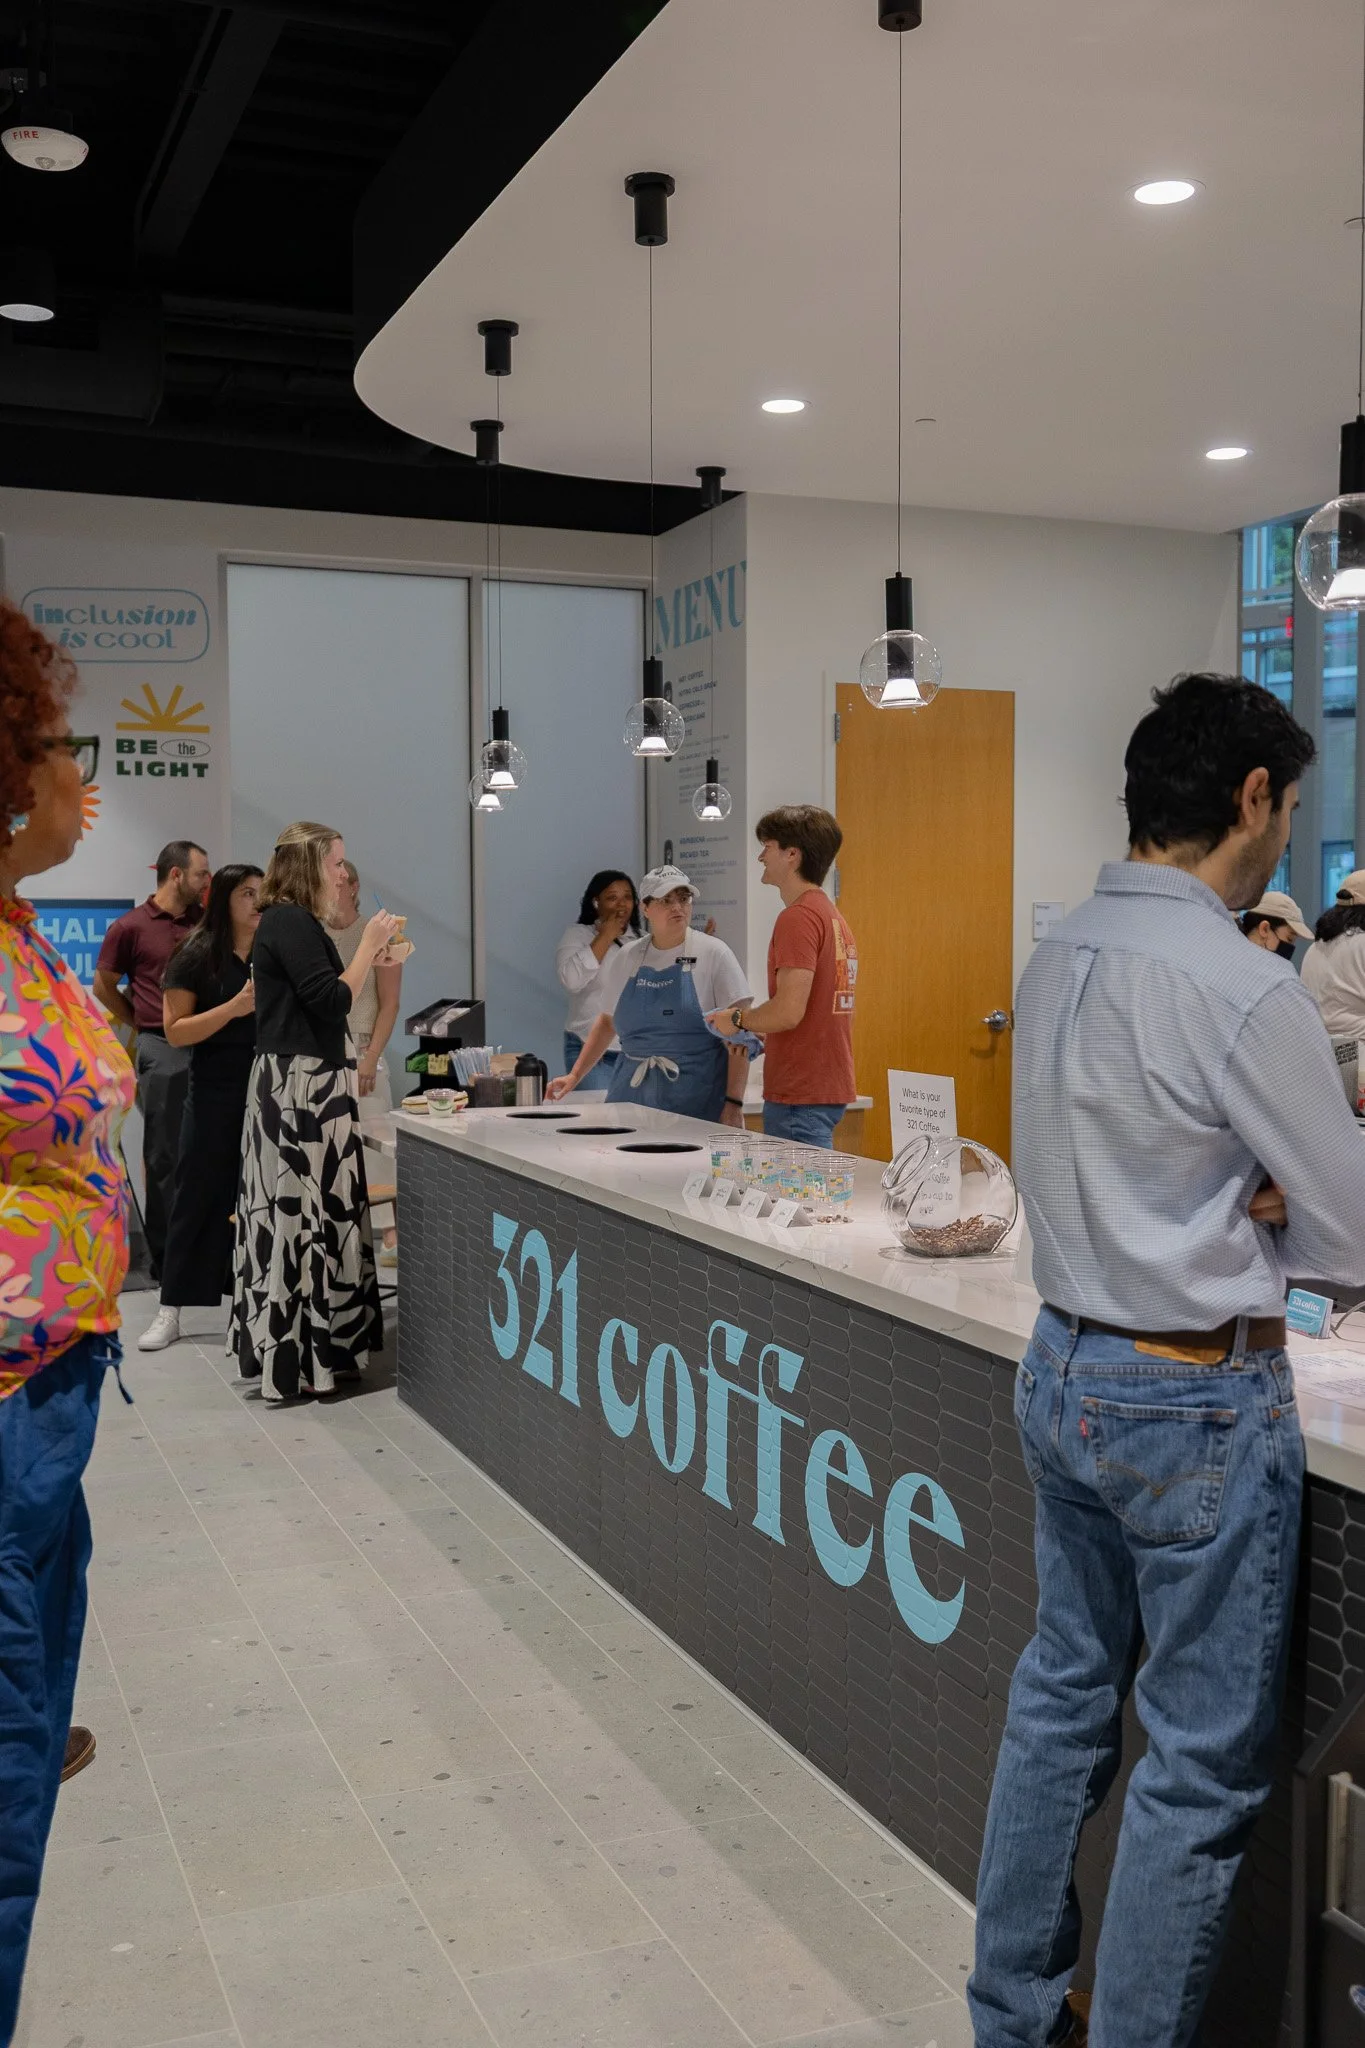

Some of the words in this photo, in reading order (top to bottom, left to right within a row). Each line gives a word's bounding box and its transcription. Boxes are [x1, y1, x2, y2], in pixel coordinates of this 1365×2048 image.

[12, 130, 40, 140] FIRE
[33, 603, 198, 626] inclusion
[655, 559, 747, 655] MENU
[59, 628, 88, 648] is
[94, 628, 178, 649] cool
[115, 738, 158, 755] BE
[177, 736, 197, 756] the
[116, 760, 209, 778] LIGHT
[37, 917, 117, 944] HAL
[902, 1087, 919, 1099] What
[920, 1090, 926, 1100] is
[926, 1093, 941, 1103] your
[899, 1102, 923, 1115] favorite
[923, 1106, 938, 1119] type
[938, 1108, 947, 1119] of
[907, 1118, 918, 1130] 321
[918, 1120, 941, 1134] Coffee
[488, 1211, 582, 1408] 321
[597, 1319, 967, 1645] coffee
